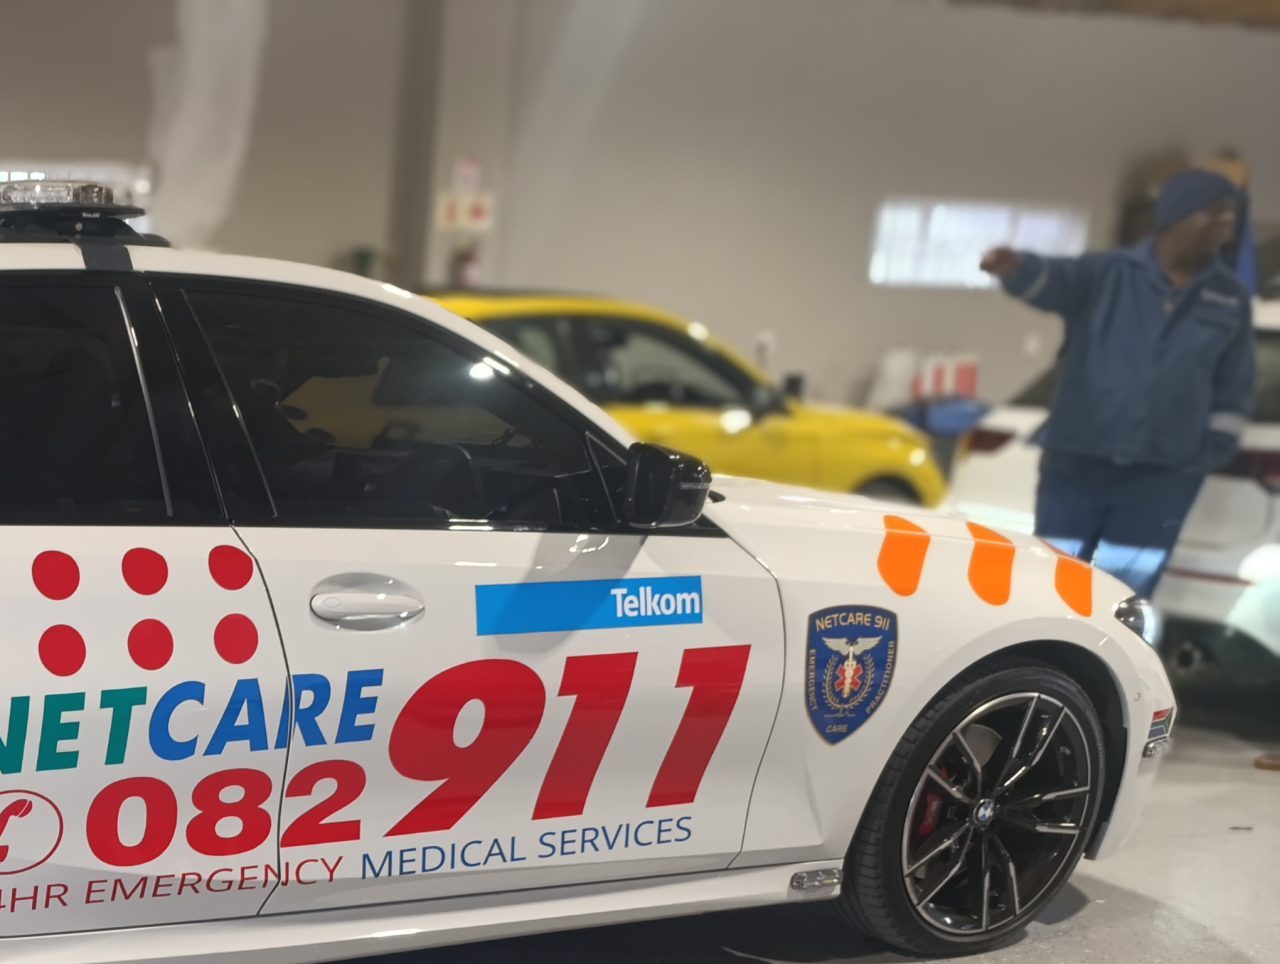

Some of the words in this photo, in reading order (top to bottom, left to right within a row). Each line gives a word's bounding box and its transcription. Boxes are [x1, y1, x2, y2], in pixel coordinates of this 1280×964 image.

[610, 586, 700, 617] Telkom
[816, 612, 871, 632] NETCARE
[874, 615, 890, 631] 911
[808, 649, 818, 711] EMERGENCY
[865, 640, 895, 714] PRACTITIONER
[85, 759, 368, 867] 082
[384, 644, 752, 837] 911
[826, 724, 848, 733] CARE
[85, 856, 343, 904] EMERGENCY
[361, 836, 526, 880] MEDICAL
[538, 816, 693, 858] SERVICES
